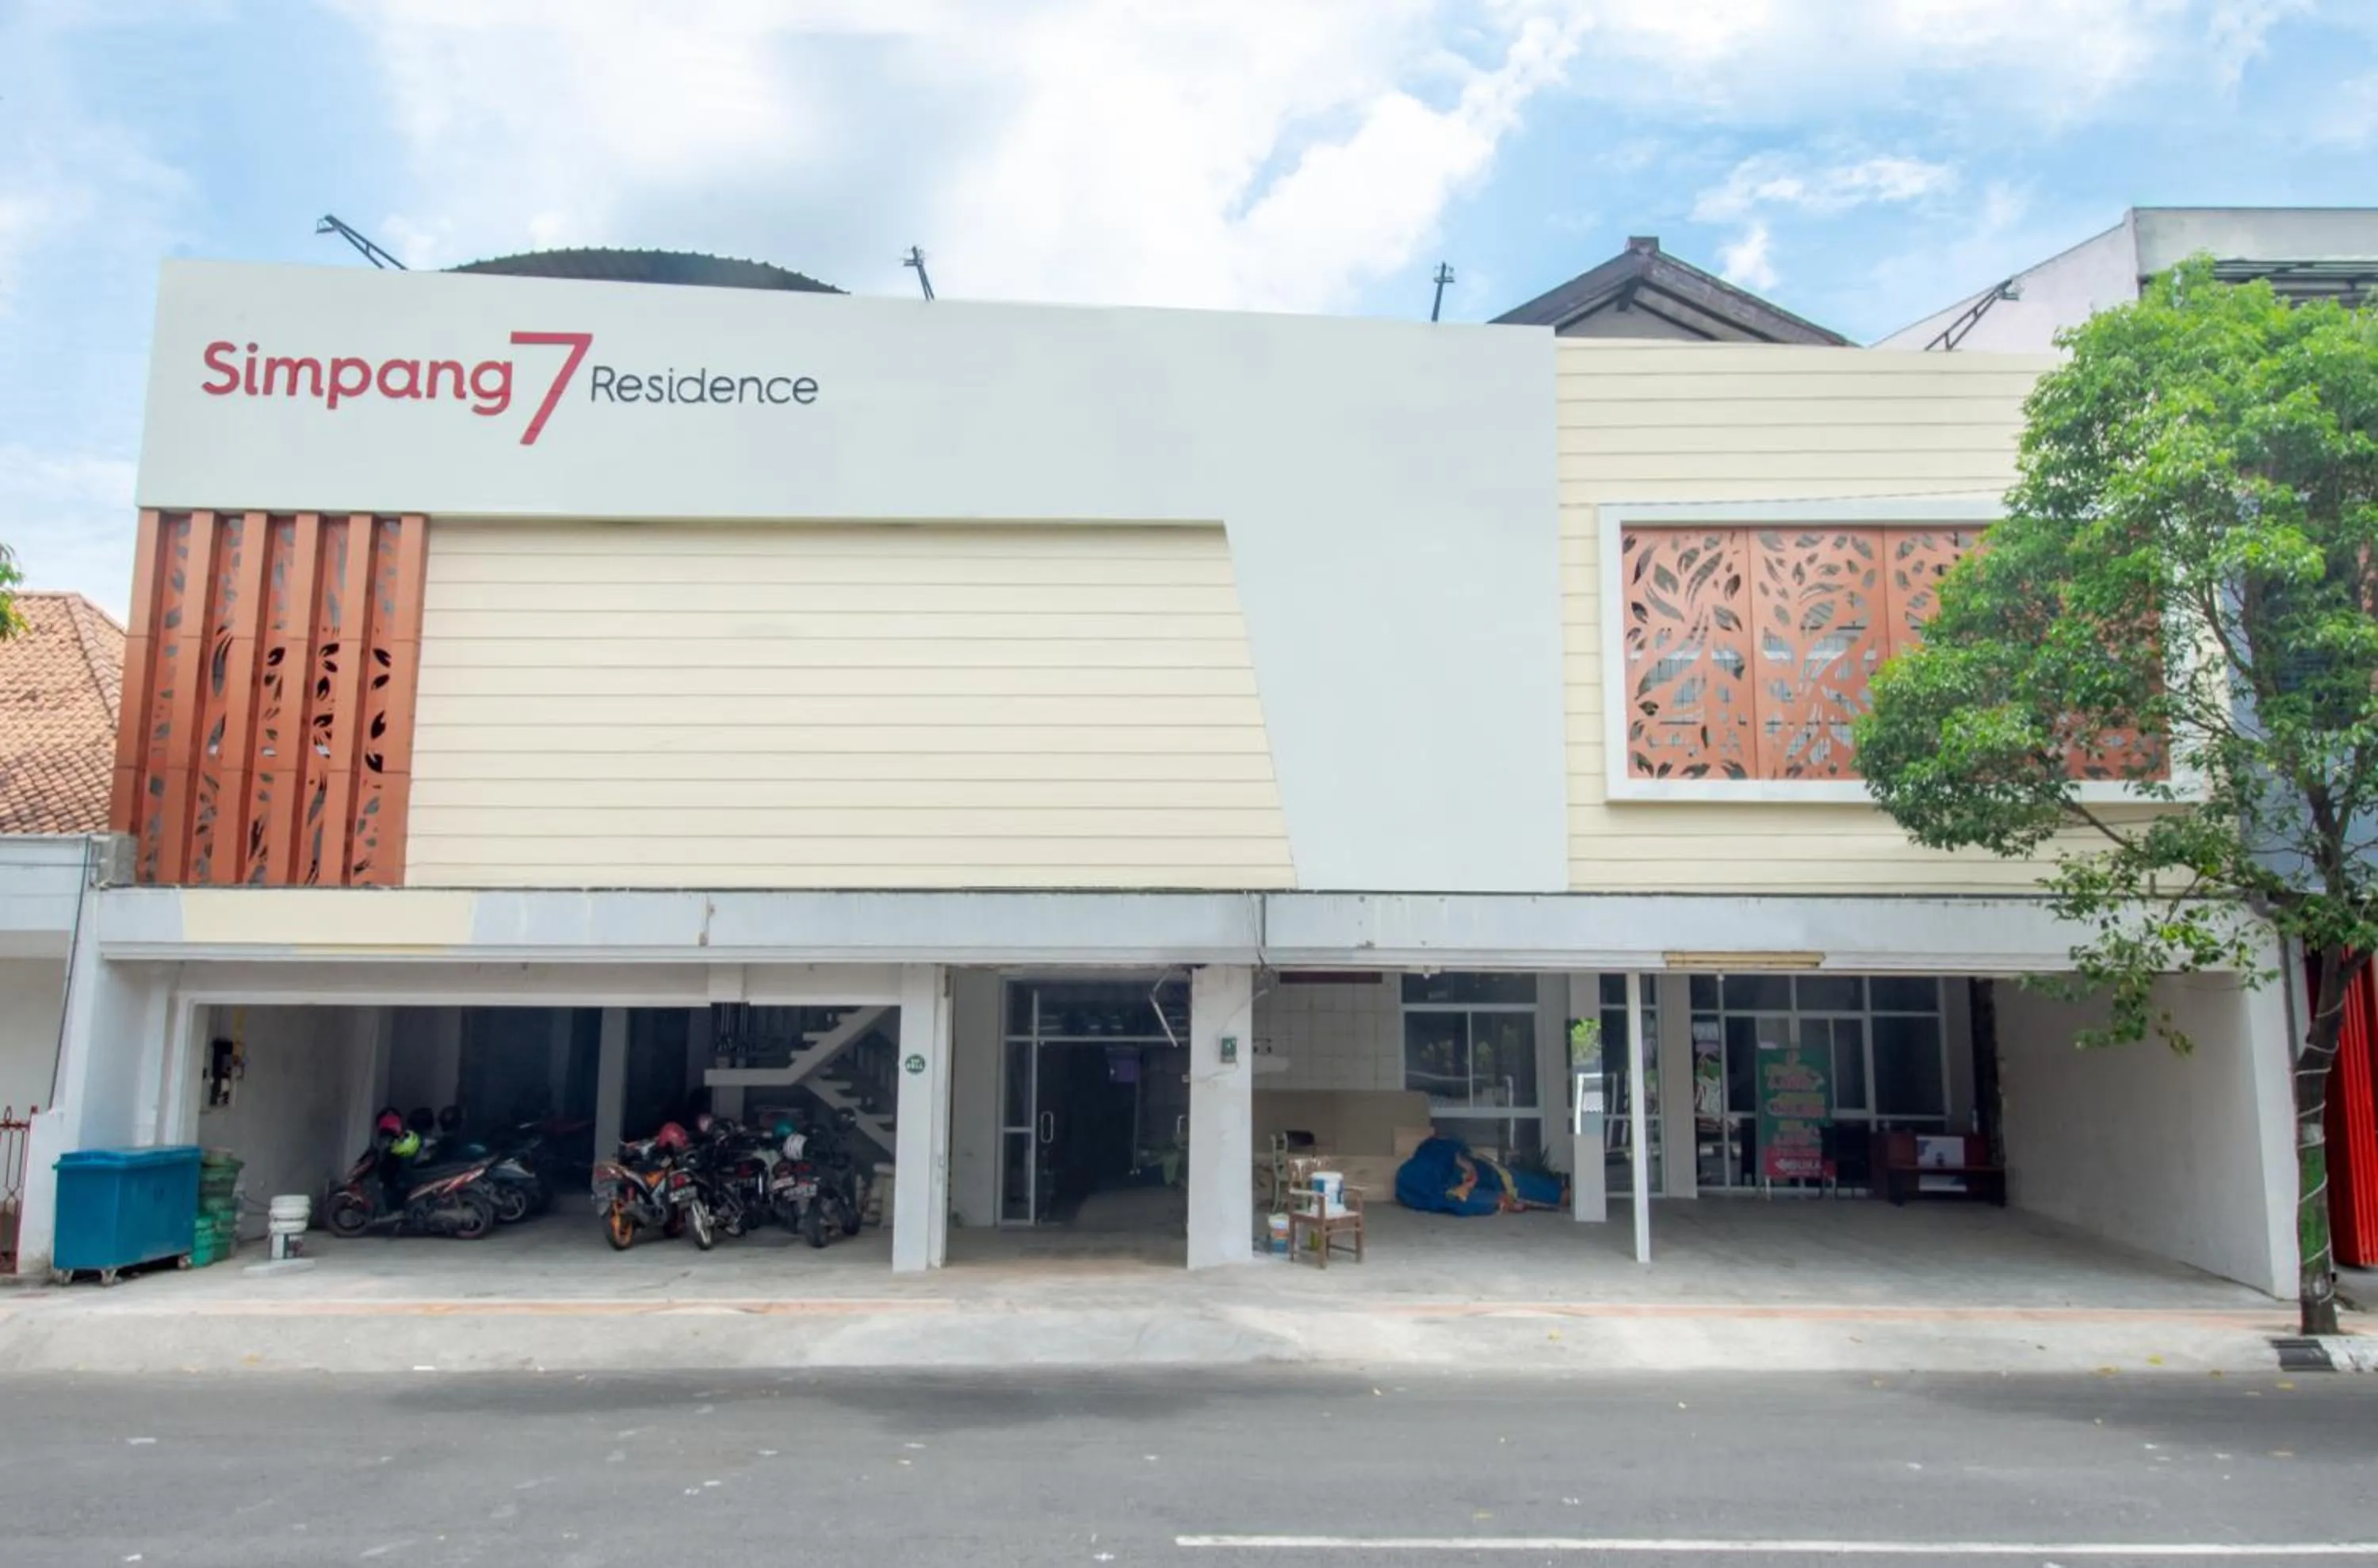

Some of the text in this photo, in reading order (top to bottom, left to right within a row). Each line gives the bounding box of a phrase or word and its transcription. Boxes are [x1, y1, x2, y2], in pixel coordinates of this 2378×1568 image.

[202, 331, 819, 445] Simpang 7 Residence
